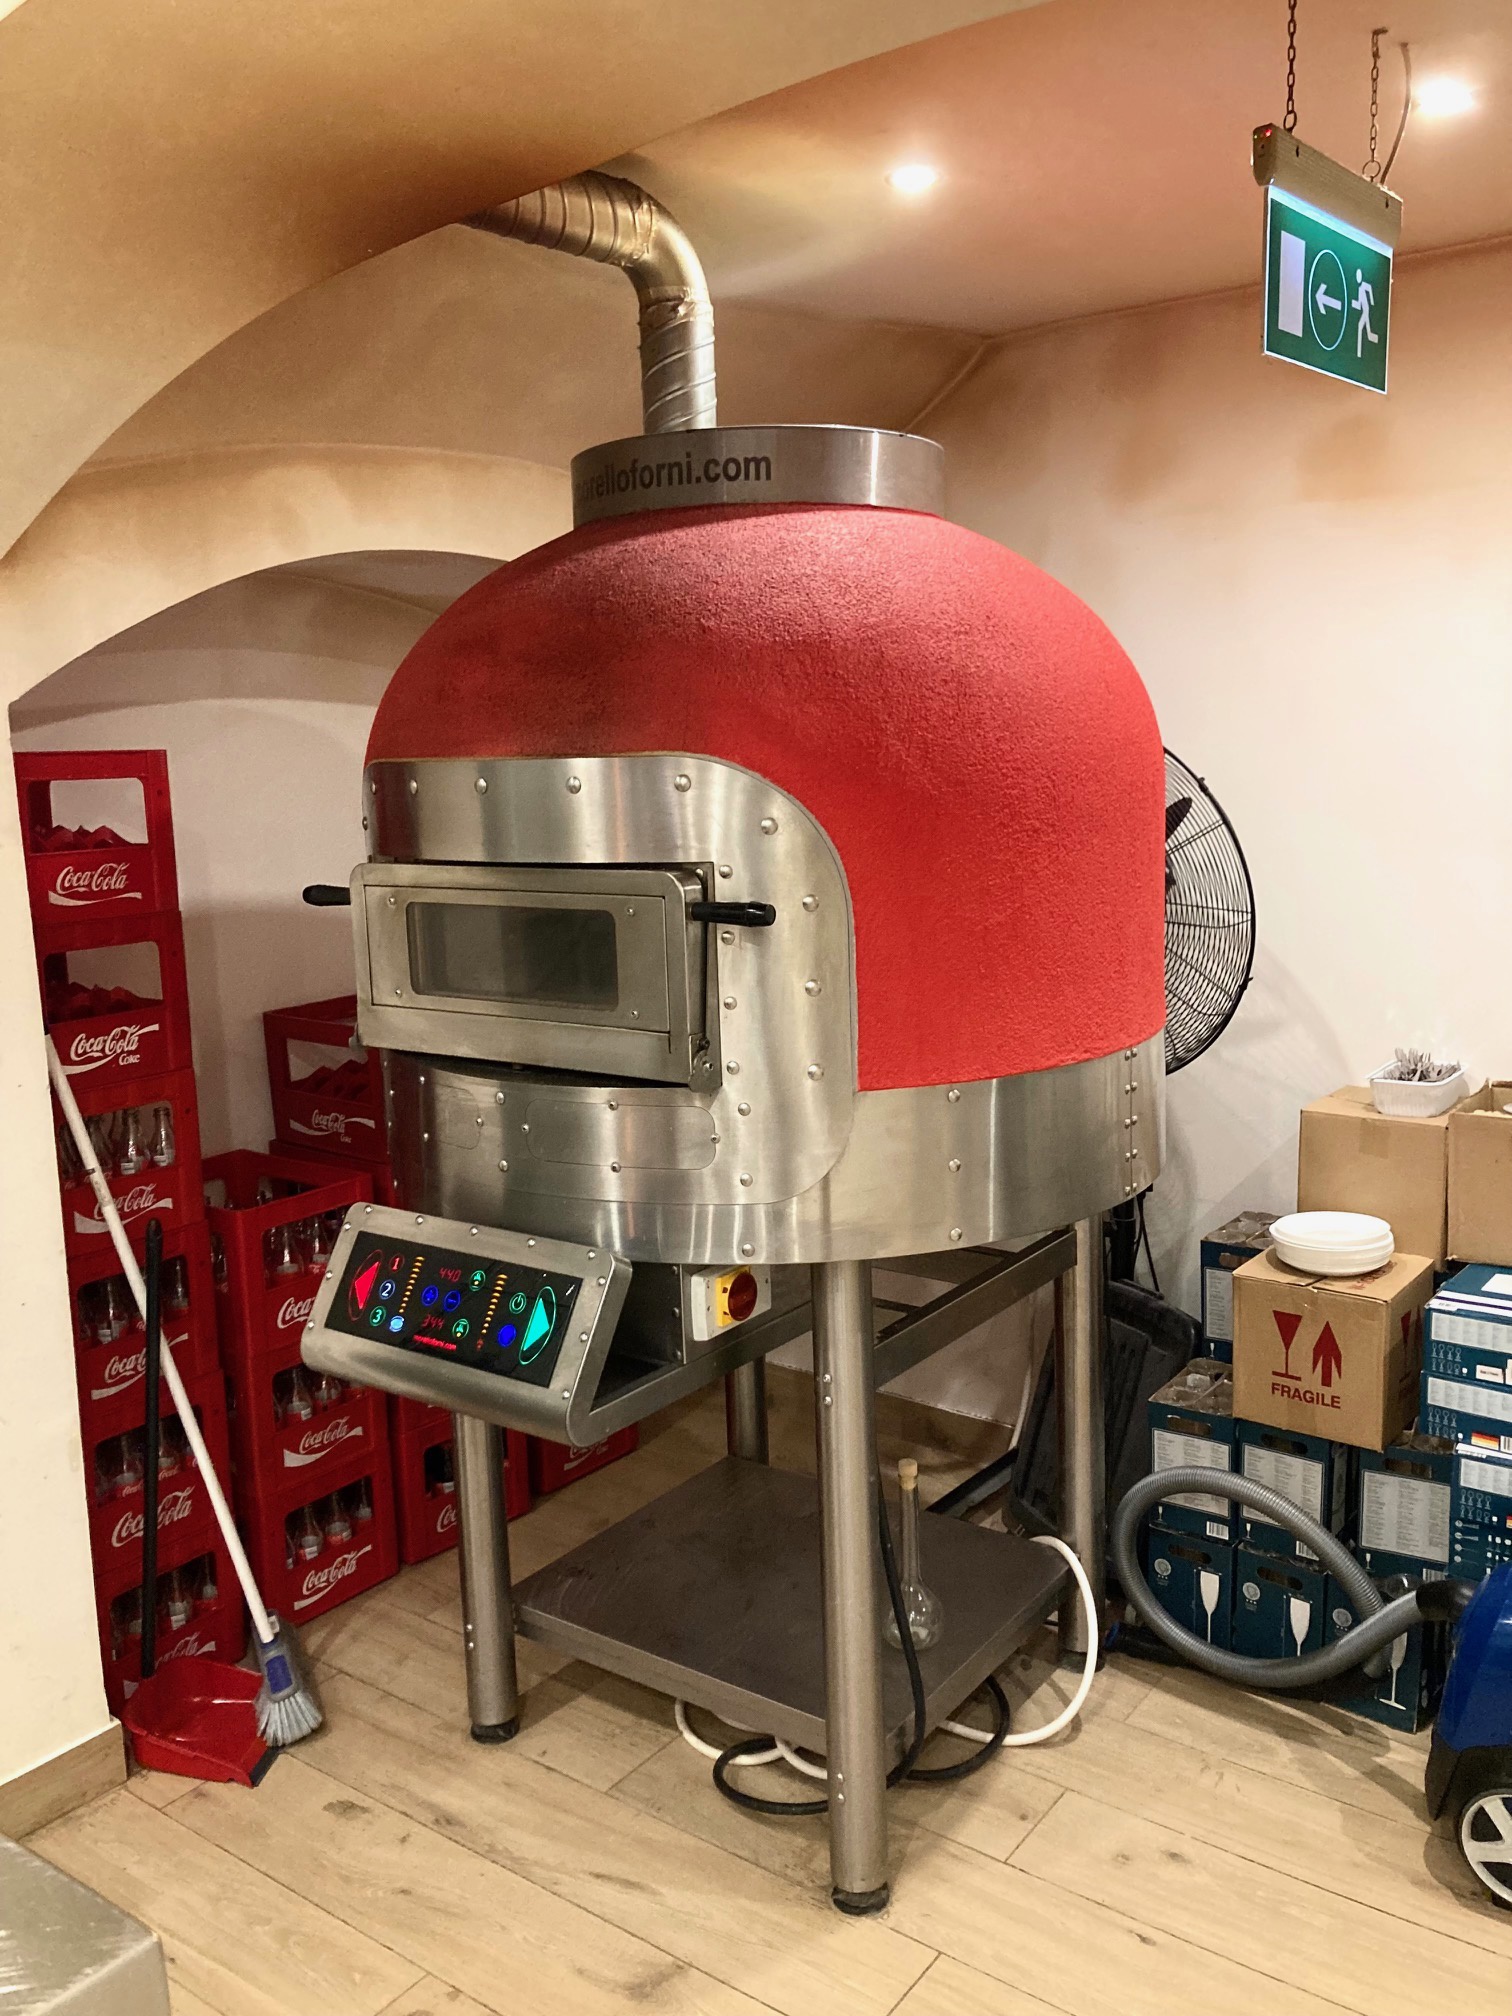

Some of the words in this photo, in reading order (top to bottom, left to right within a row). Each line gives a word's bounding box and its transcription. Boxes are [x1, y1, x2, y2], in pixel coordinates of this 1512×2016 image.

[56, 862, 131, 895] Coca-Cola
[70, 1024, 141, 1061] Coca-Cola
[118, 1053, 141, 1066] Coke
[392, 1257, 400, 1270] 1
[439, 1267, 462, 1282] 440
[381, 1282, 392, 1297] 2
[372, 1309, 383, 1323] 3
[422, 1314, 445, 1330] 344
[1271, 1382, 1341, 1410] FRAGILE
[299, 1416, 350, 1455] Coca-Cola
[302, 1551, 358, 1595] Coca-Cola
